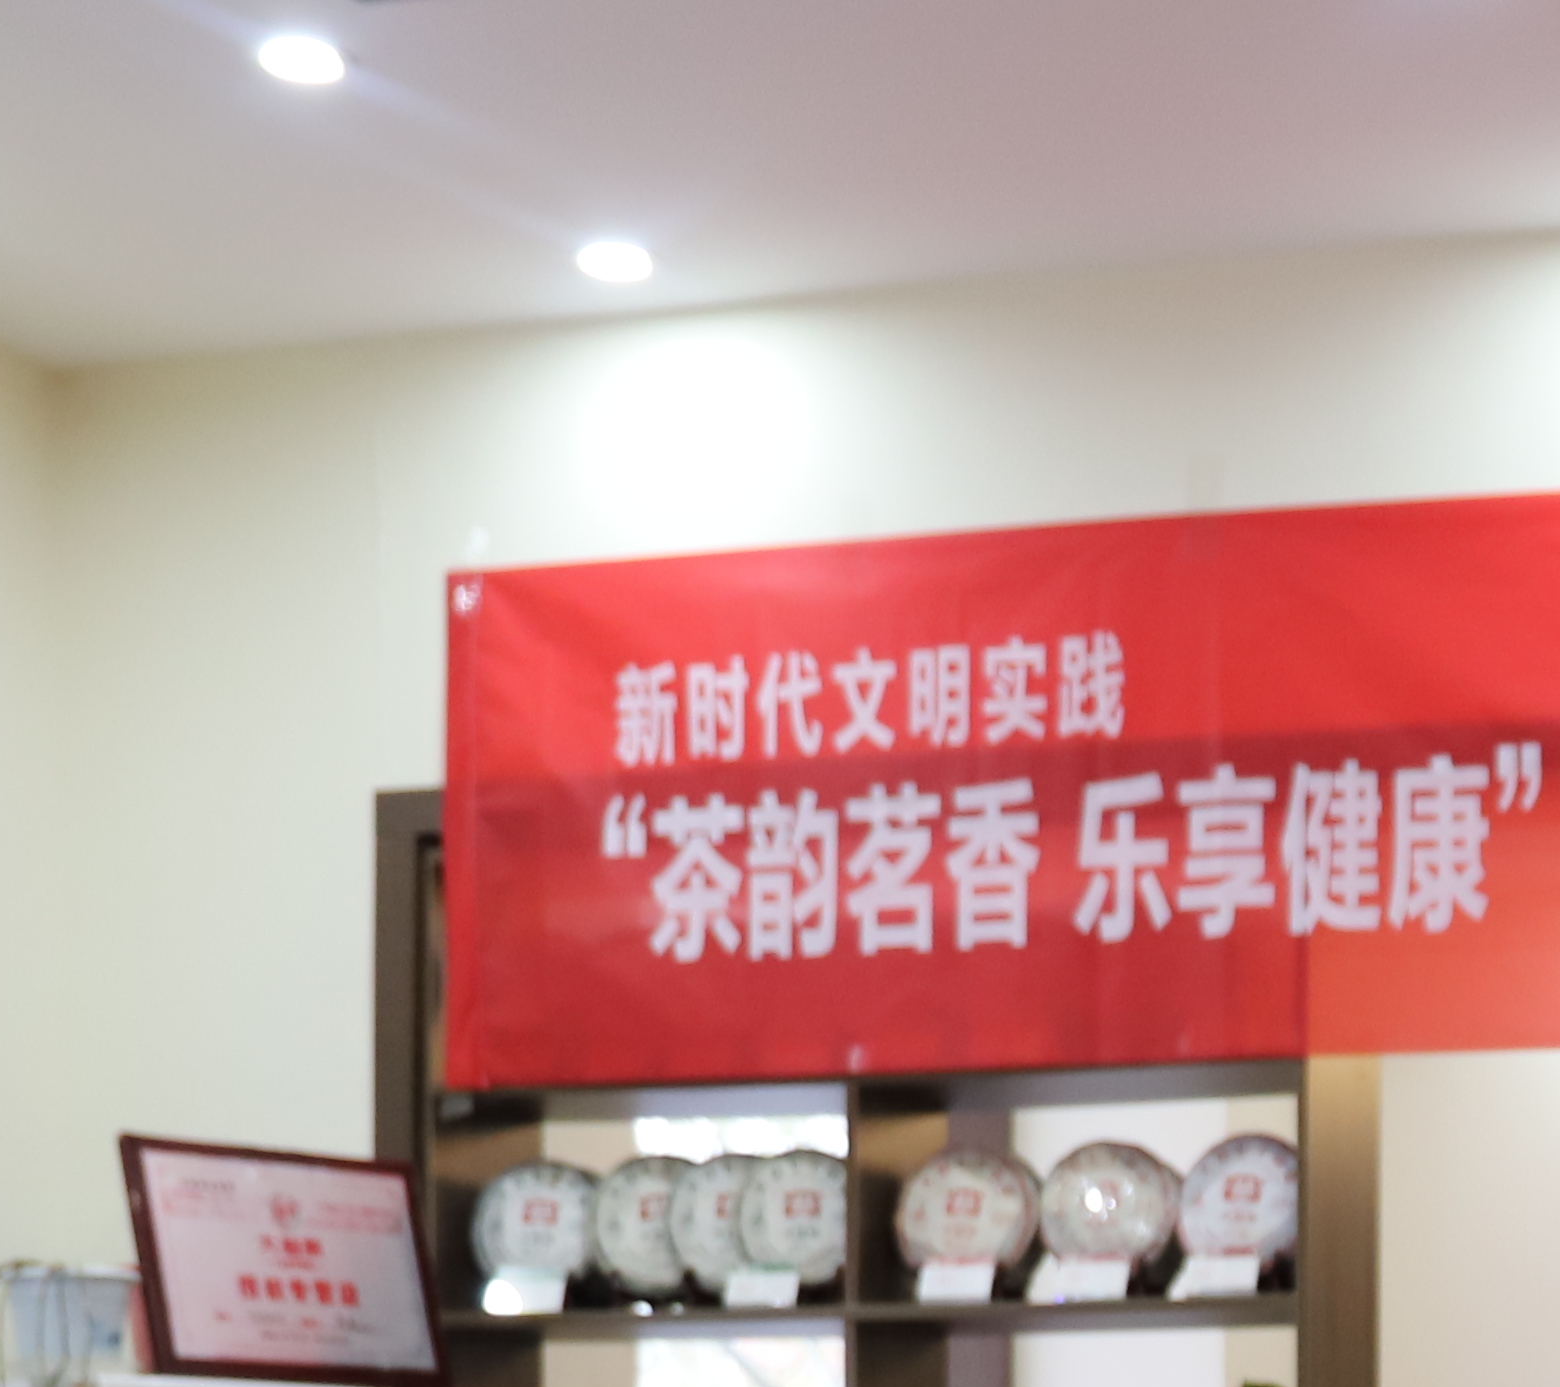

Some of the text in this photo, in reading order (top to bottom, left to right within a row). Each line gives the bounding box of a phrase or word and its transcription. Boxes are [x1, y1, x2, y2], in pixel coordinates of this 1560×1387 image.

[613, 629, 1127, 766] 新时代文明实践
